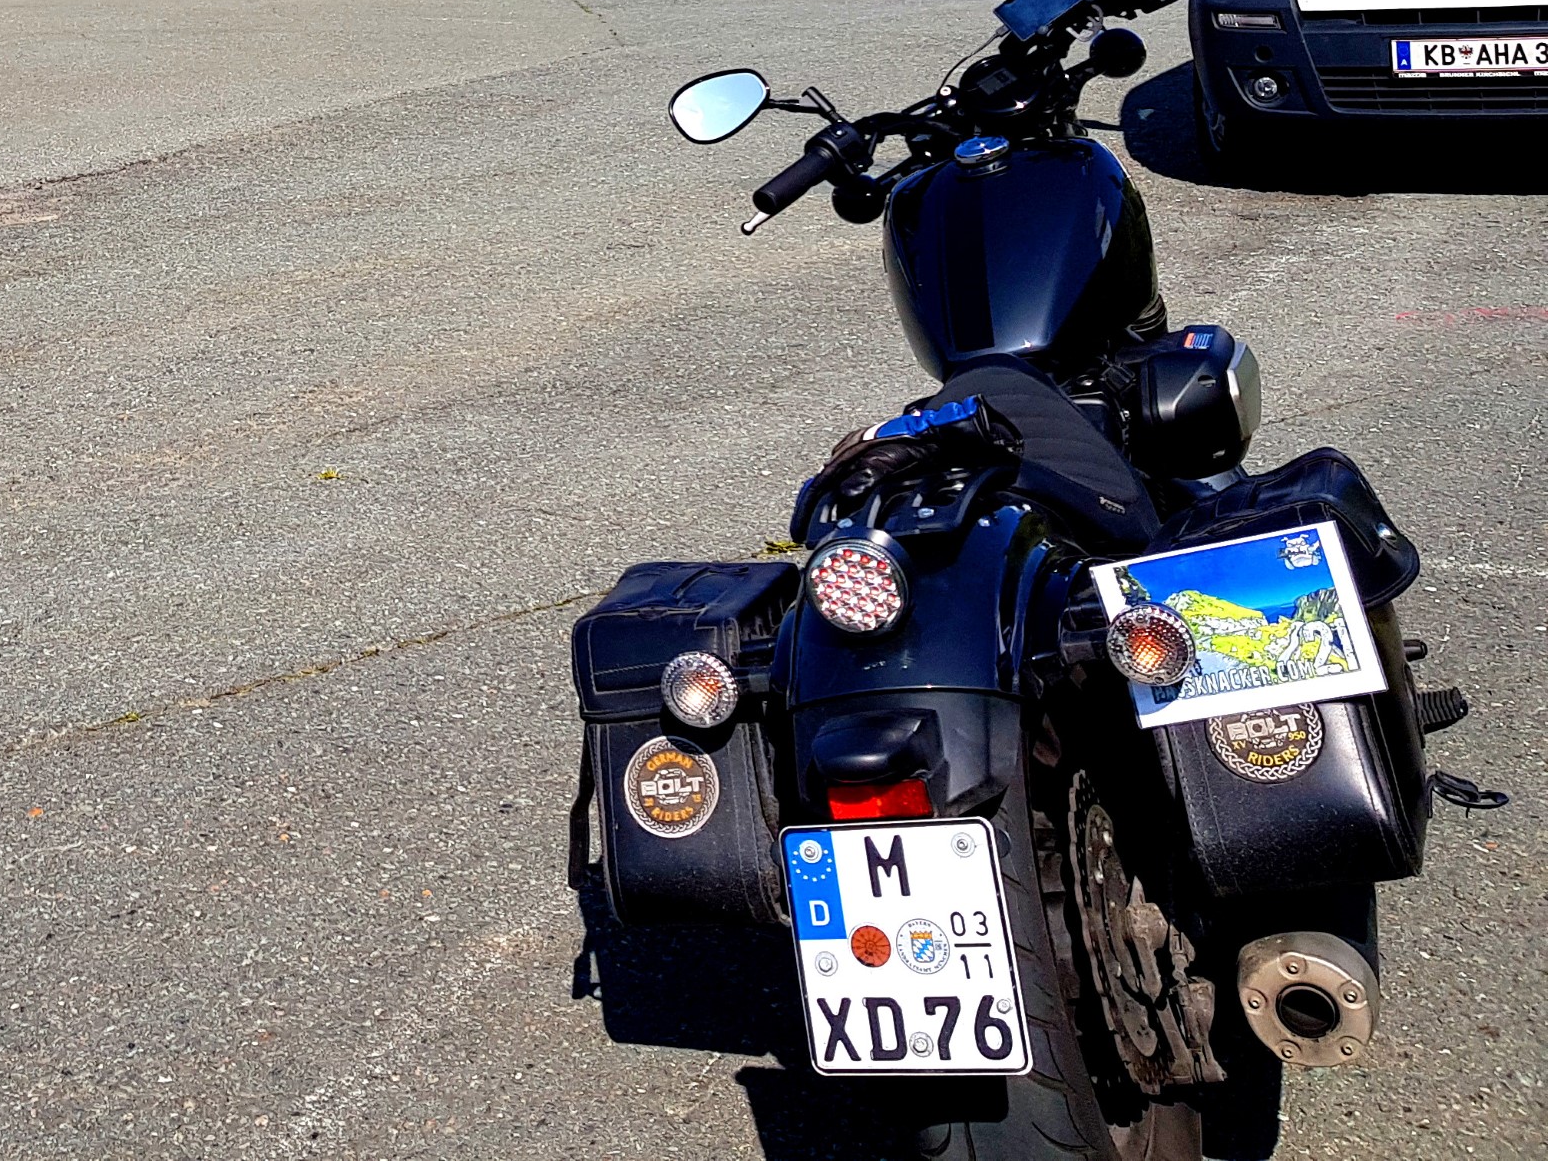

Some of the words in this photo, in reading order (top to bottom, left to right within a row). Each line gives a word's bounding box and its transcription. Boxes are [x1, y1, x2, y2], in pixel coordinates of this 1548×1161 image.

[1423, 44, 1456, 66] KB
[1476, 42, 1529, 66] AHA
[1535, 42, 1548, 65] 3
[1226, 713, 1302, 741] BOLT
[1288, 730, 1307, 741] 950
[646, 752, 694, 771] GERMAN
[1247, 745, 1301, 767] RIDERS
[640, 777, 704, 796] BOLT
[650, 806, 694, 821] RIDERS
[863, 834, 911, 898] M
[808, 900, 831, 926] D
[950, 911, 989, 937] 03
[959, 953, 994, 980] 11
